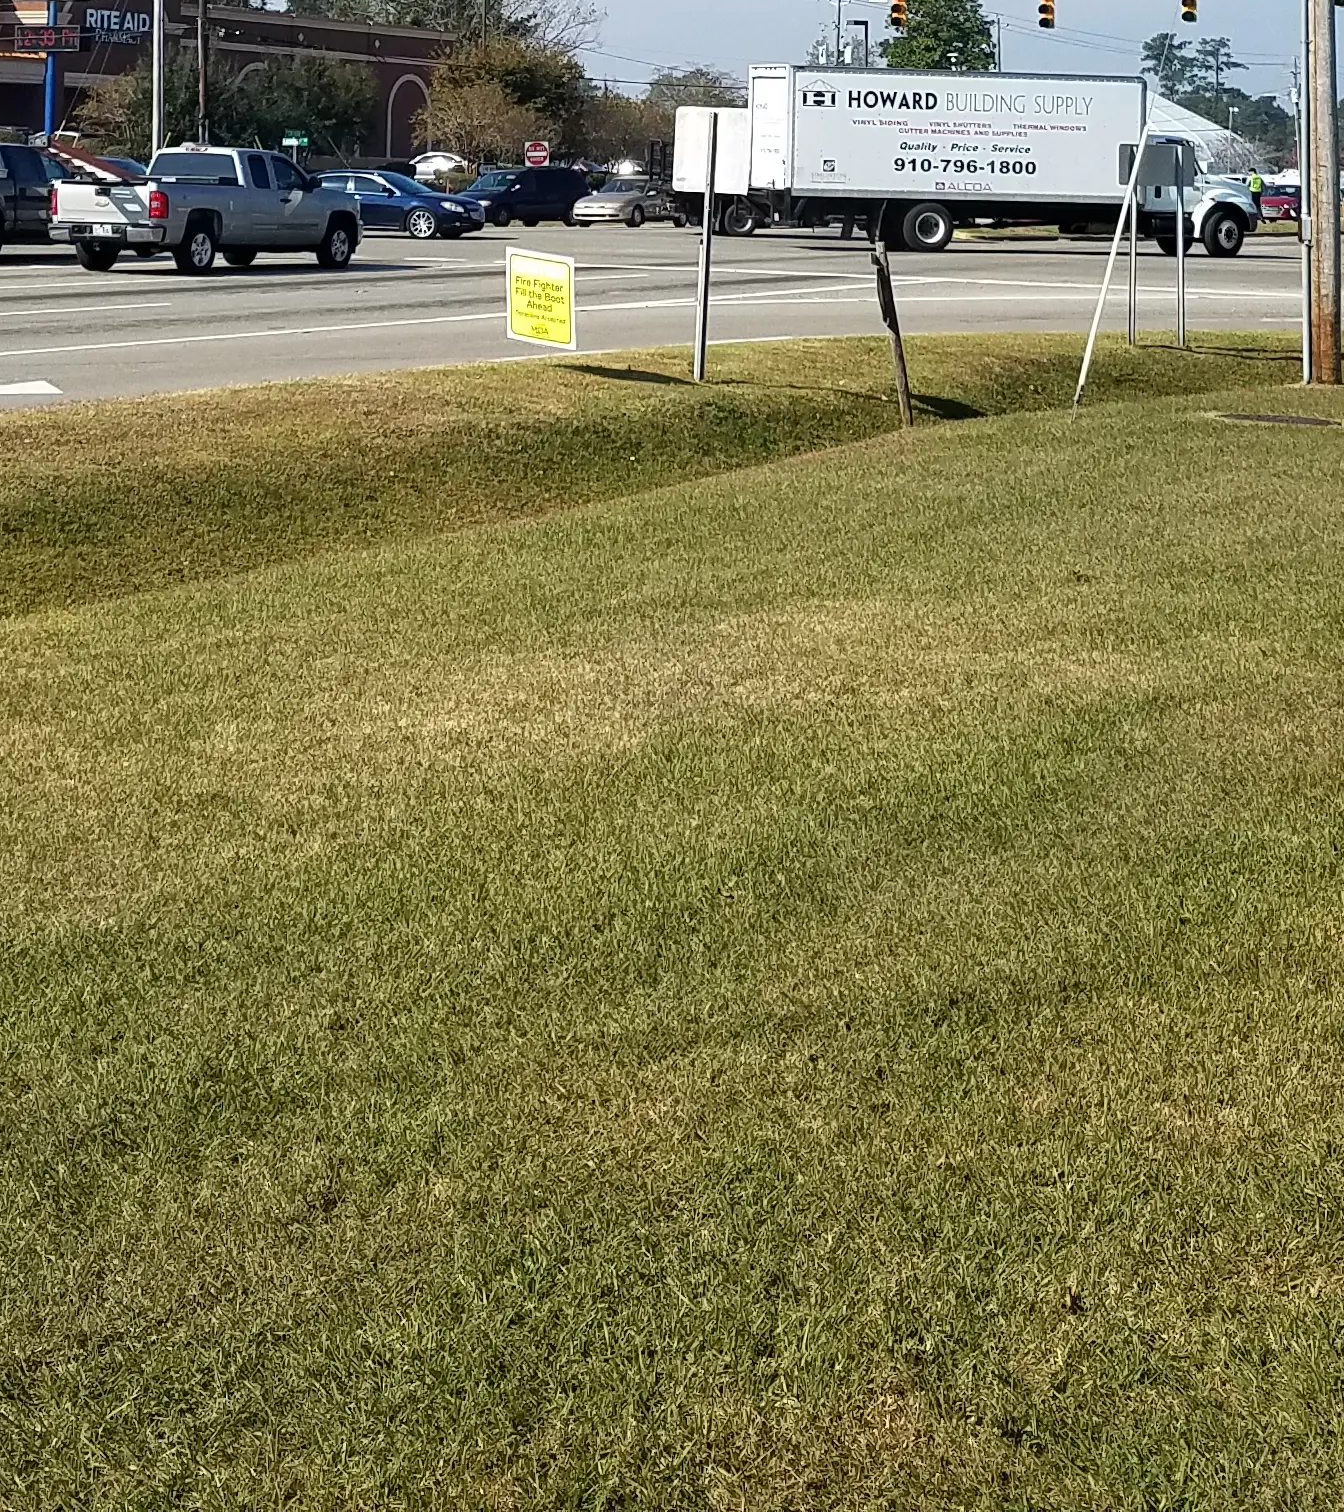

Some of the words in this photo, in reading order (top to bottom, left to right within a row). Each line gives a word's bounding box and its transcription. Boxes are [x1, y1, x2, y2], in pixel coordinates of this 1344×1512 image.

[86, 9, 120, 29] RITE
[124, 12, 150, 32] AID
[848, 90, 937, 109] HOWARD
[946, 93, 1025, 113] BUILDING
[1034, 96, 1093, 115] SUPPLY
[900, 142, 938, 152] Quality
[951, 143, 978, 152] Price
[991, 144, 1031, 153] Service
[894, 158, 1036, 174] 910-796-1800
[947, 182, 992, 191] ALCOA
[516, 276, 531, 286] Fire
[533, 279, 564, 292] Fighter
[516, 287, 527, 296] Fill
[528, 291, 542, 300] the
[544, 293, 565, 304] Boot
[527, 300, 552, 312] Ahead
